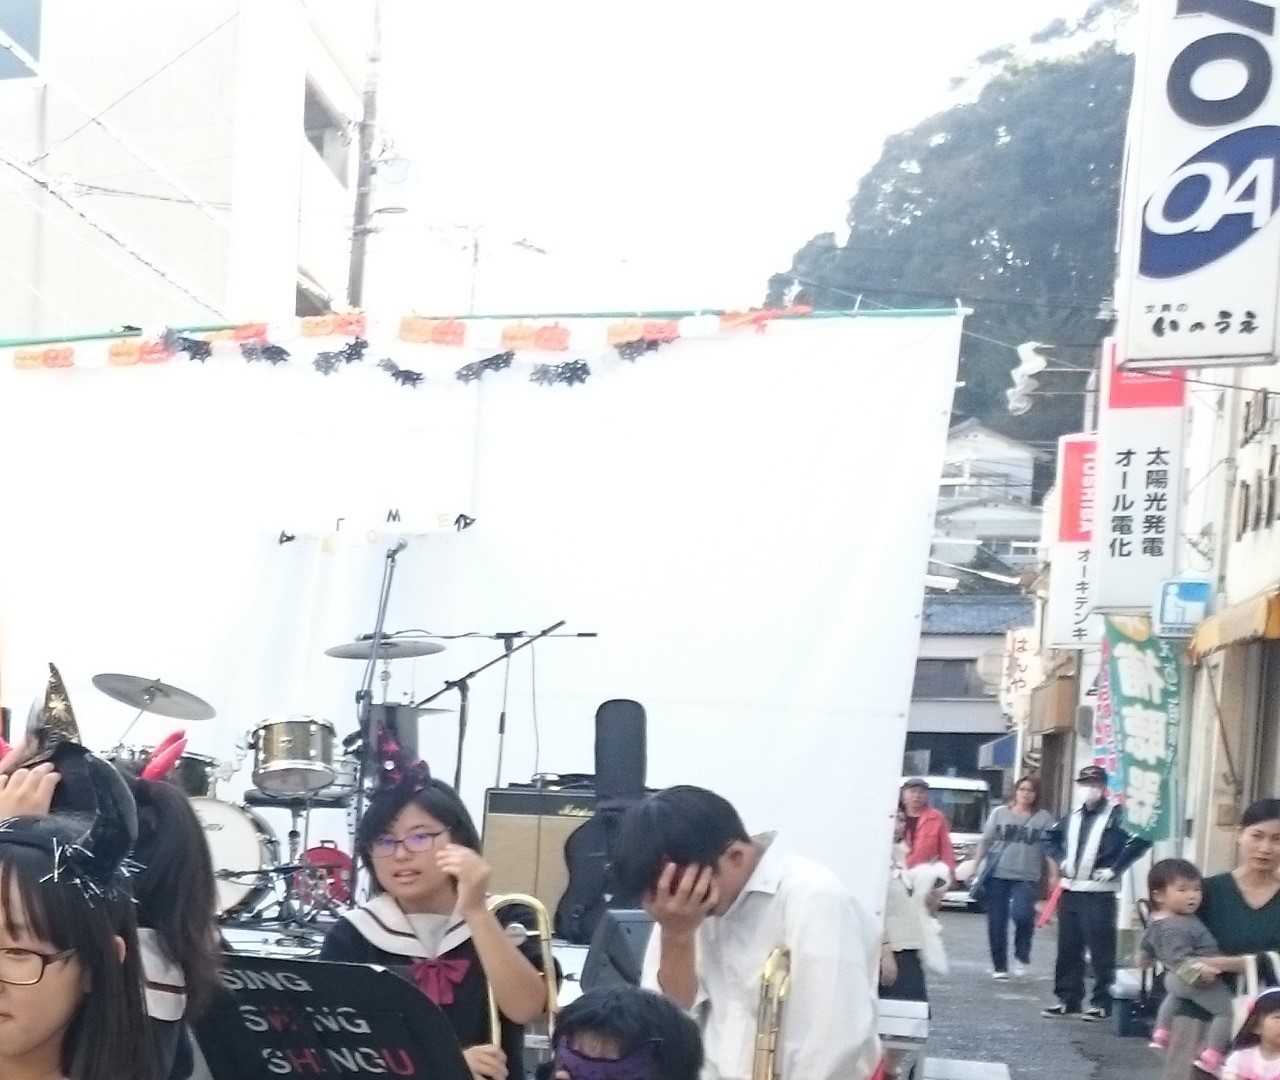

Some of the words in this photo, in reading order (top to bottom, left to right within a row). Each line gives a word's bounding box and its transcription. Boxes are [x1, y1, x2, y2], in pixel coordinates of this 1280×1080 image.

[1146, 158, 1275, 235] OA
[1151, 310, 1260, 338] いのうえ
[1109, 448, 1137, 559] オール電化
[1141, 446, 1171, 557] 太陽光発電
[222, 969, 313, 993] SING
[239, 1005, 372, 1034] SWNG
[261, 1047, 416, 1076] SHNGU
